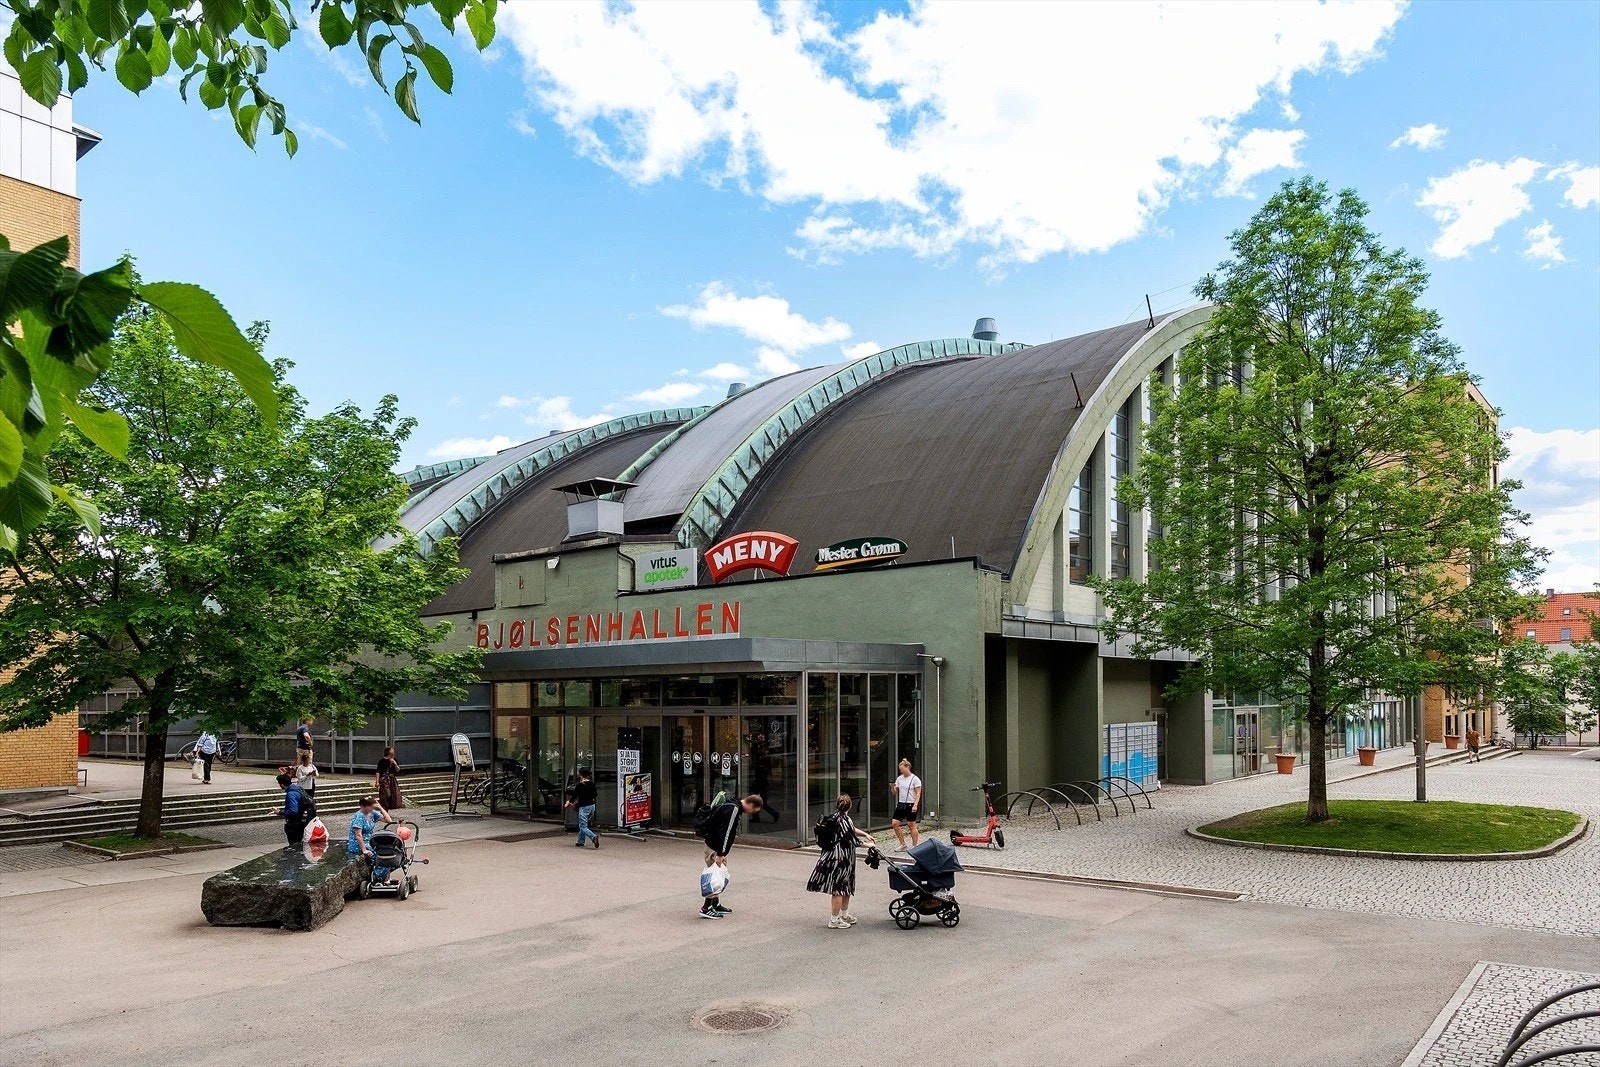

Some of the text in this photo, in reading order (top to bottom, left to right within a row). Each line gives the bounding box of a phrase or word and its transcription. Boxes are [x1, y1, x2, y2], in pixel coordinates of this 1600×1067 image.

[713, 540, 785, 570] MENY
[818, 542, 901, 562] Mester Grønn
[650, 556, 677, 569] vitus
[477, 602, 741, 649] BJØLSENHALLEN
[620, 758, 637, 767] STORT
